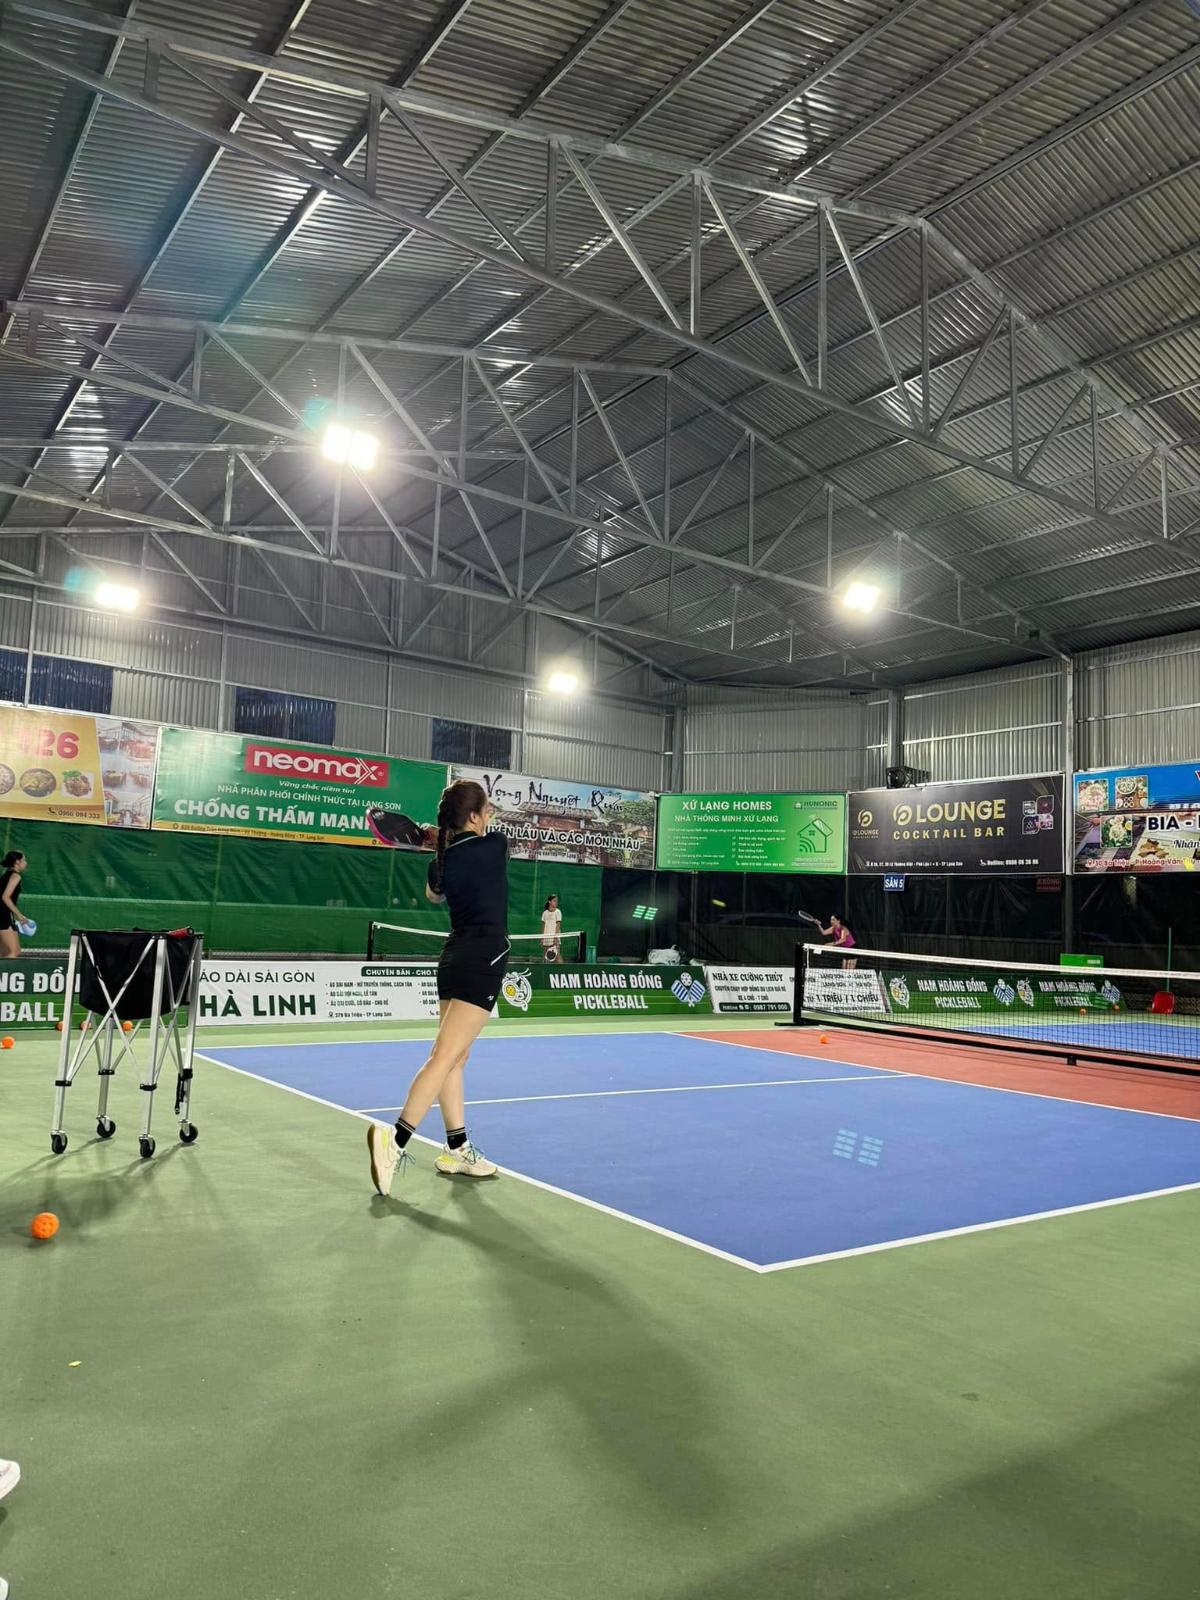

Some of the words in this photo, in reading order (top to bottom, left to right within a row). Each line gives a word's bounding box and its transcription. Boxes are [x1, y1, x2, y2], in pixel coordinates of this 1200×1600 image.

[254, 751, 379, 785] neomax
[217, 783, 239, 794] NHÀ
[241, 785, 267, 797] PHÂN
[269, 788, 291, 799] PHỐI
[293, 791, 320, 802] CHÍNH
[323, 795, 345, 805] THỨC
[347, 799, 360, 808] TẠI
[385, 801, 401, 810] SƠN
[174, 796, 250, 820] CHỐNG
[256, 805, 315, 826] THẤM
[700, 801, 730, 813] LẠNG
[733, 801, 772, 811] HOMES
[916, 799, 1006, 823] LOUNGE
[675, 814, 691, 822] NHÀ
[692, 814, 720, 822] THÔNG
[1148, 816, 1180, 831] BIA
[540, 827, 556, 841] VÀ
[559, 830, 583, 844] CÁC
[585, 834, 610, 846] MÓN
[613, 838, 640, 852] NHẬU
[893, 828, 967, 840] COCKTAIL
[974, 826, 1005, 838] BAR
[225, 969, 251, 983] DÀI
[255, 969, 279, 982] SÀI
[282, 969, 315, 982] GÒN
[366, 968, 395, 976] CHUYÊN
[550, 973, 581, 988] NAM
[586, 970, 628, 988] HOÀNG
[630, 970, 663, 988] ĐỒNG
[712, 971, 728, 981] NHÀ
[729, 973, 739, 981] XE
[740, 972, 764, 982] CƯỜNG
[917, 979, 937, 991] NAM
[937, 978, 965, 992] HOÀNG
[200, 989, 242, 1017] HÀ
[252, 995, 316, 1017] LINH
[574, 994, 648, 1009] PICKLEBALL
[934, 996, 981, 1008] PICKLEBALL
[1, 1002, 60, 1022] BALL
